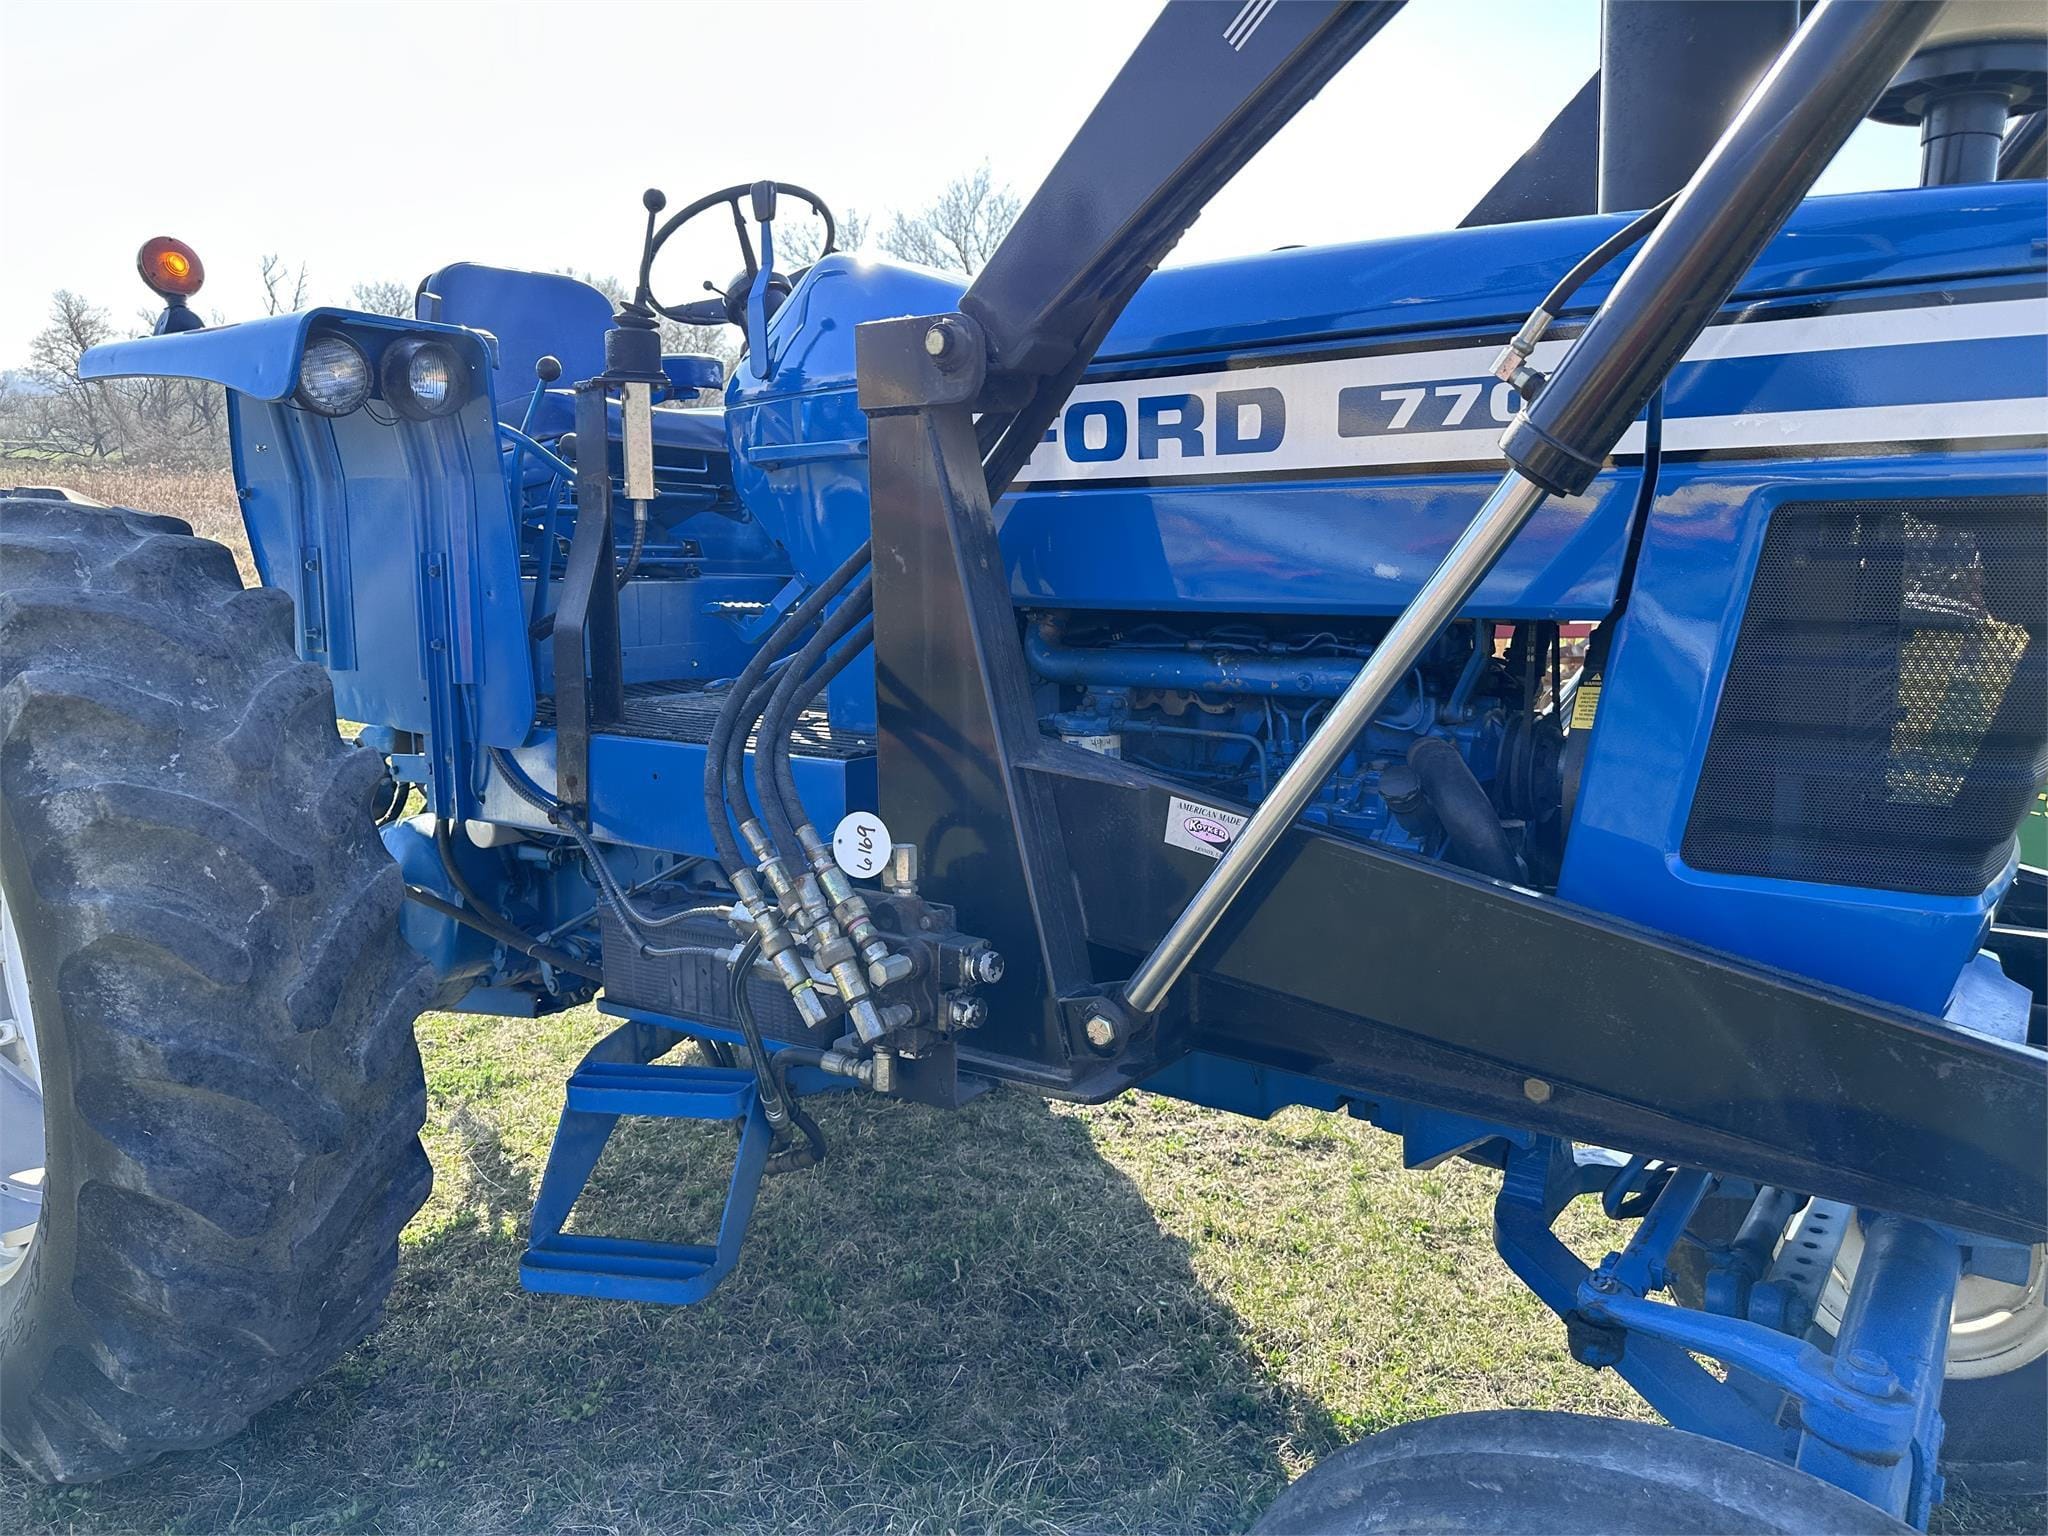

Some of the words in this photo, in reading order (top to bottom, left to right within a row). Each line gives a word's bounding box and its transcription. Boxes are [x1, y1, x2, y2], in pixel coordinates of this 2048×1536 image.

[1177, 802, 1217, 819] AMERICAN
[1219, 814, 1242, 826] MADE
[1189, 819, 1226, 840] KOYKER
[856, 824, 876, 871] 6169
